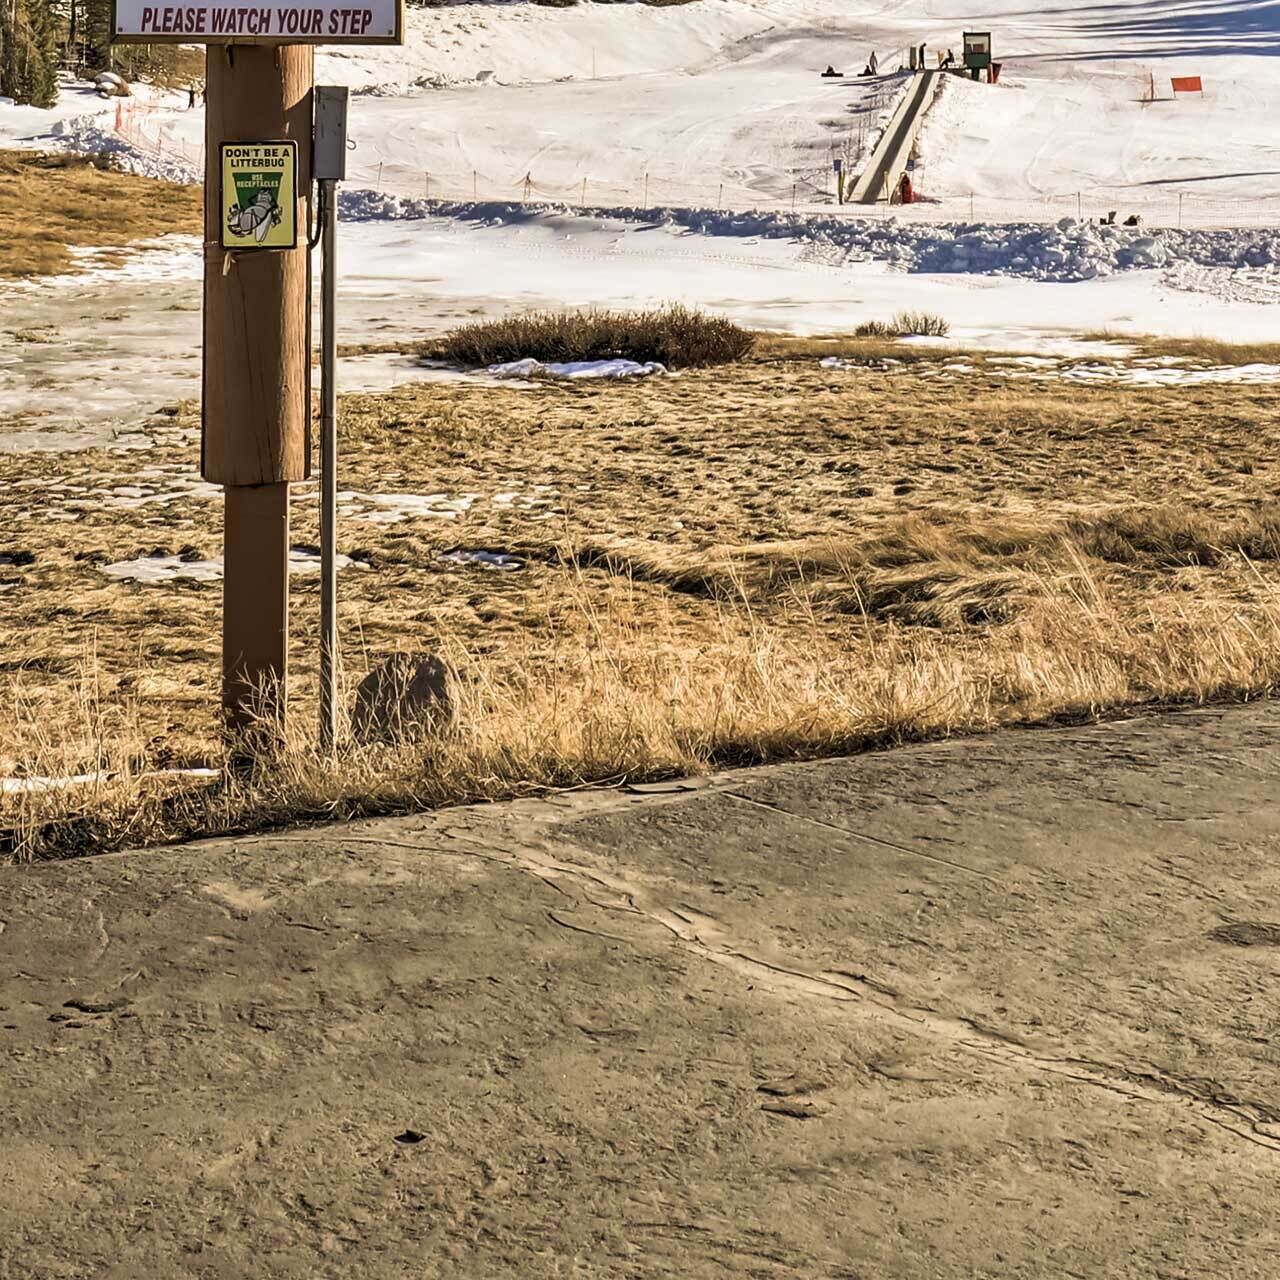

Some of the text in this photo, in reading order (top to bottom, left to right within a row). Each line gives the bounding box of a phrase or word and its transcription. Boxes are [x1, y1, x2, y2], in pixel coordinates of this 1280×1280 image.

[141, 7, 373, 35] PLEASE WATCH YOUR STEP
[225, 148, 290, 157] DON'T BE A
[231, 158, 285, 167] LITTERBUG
